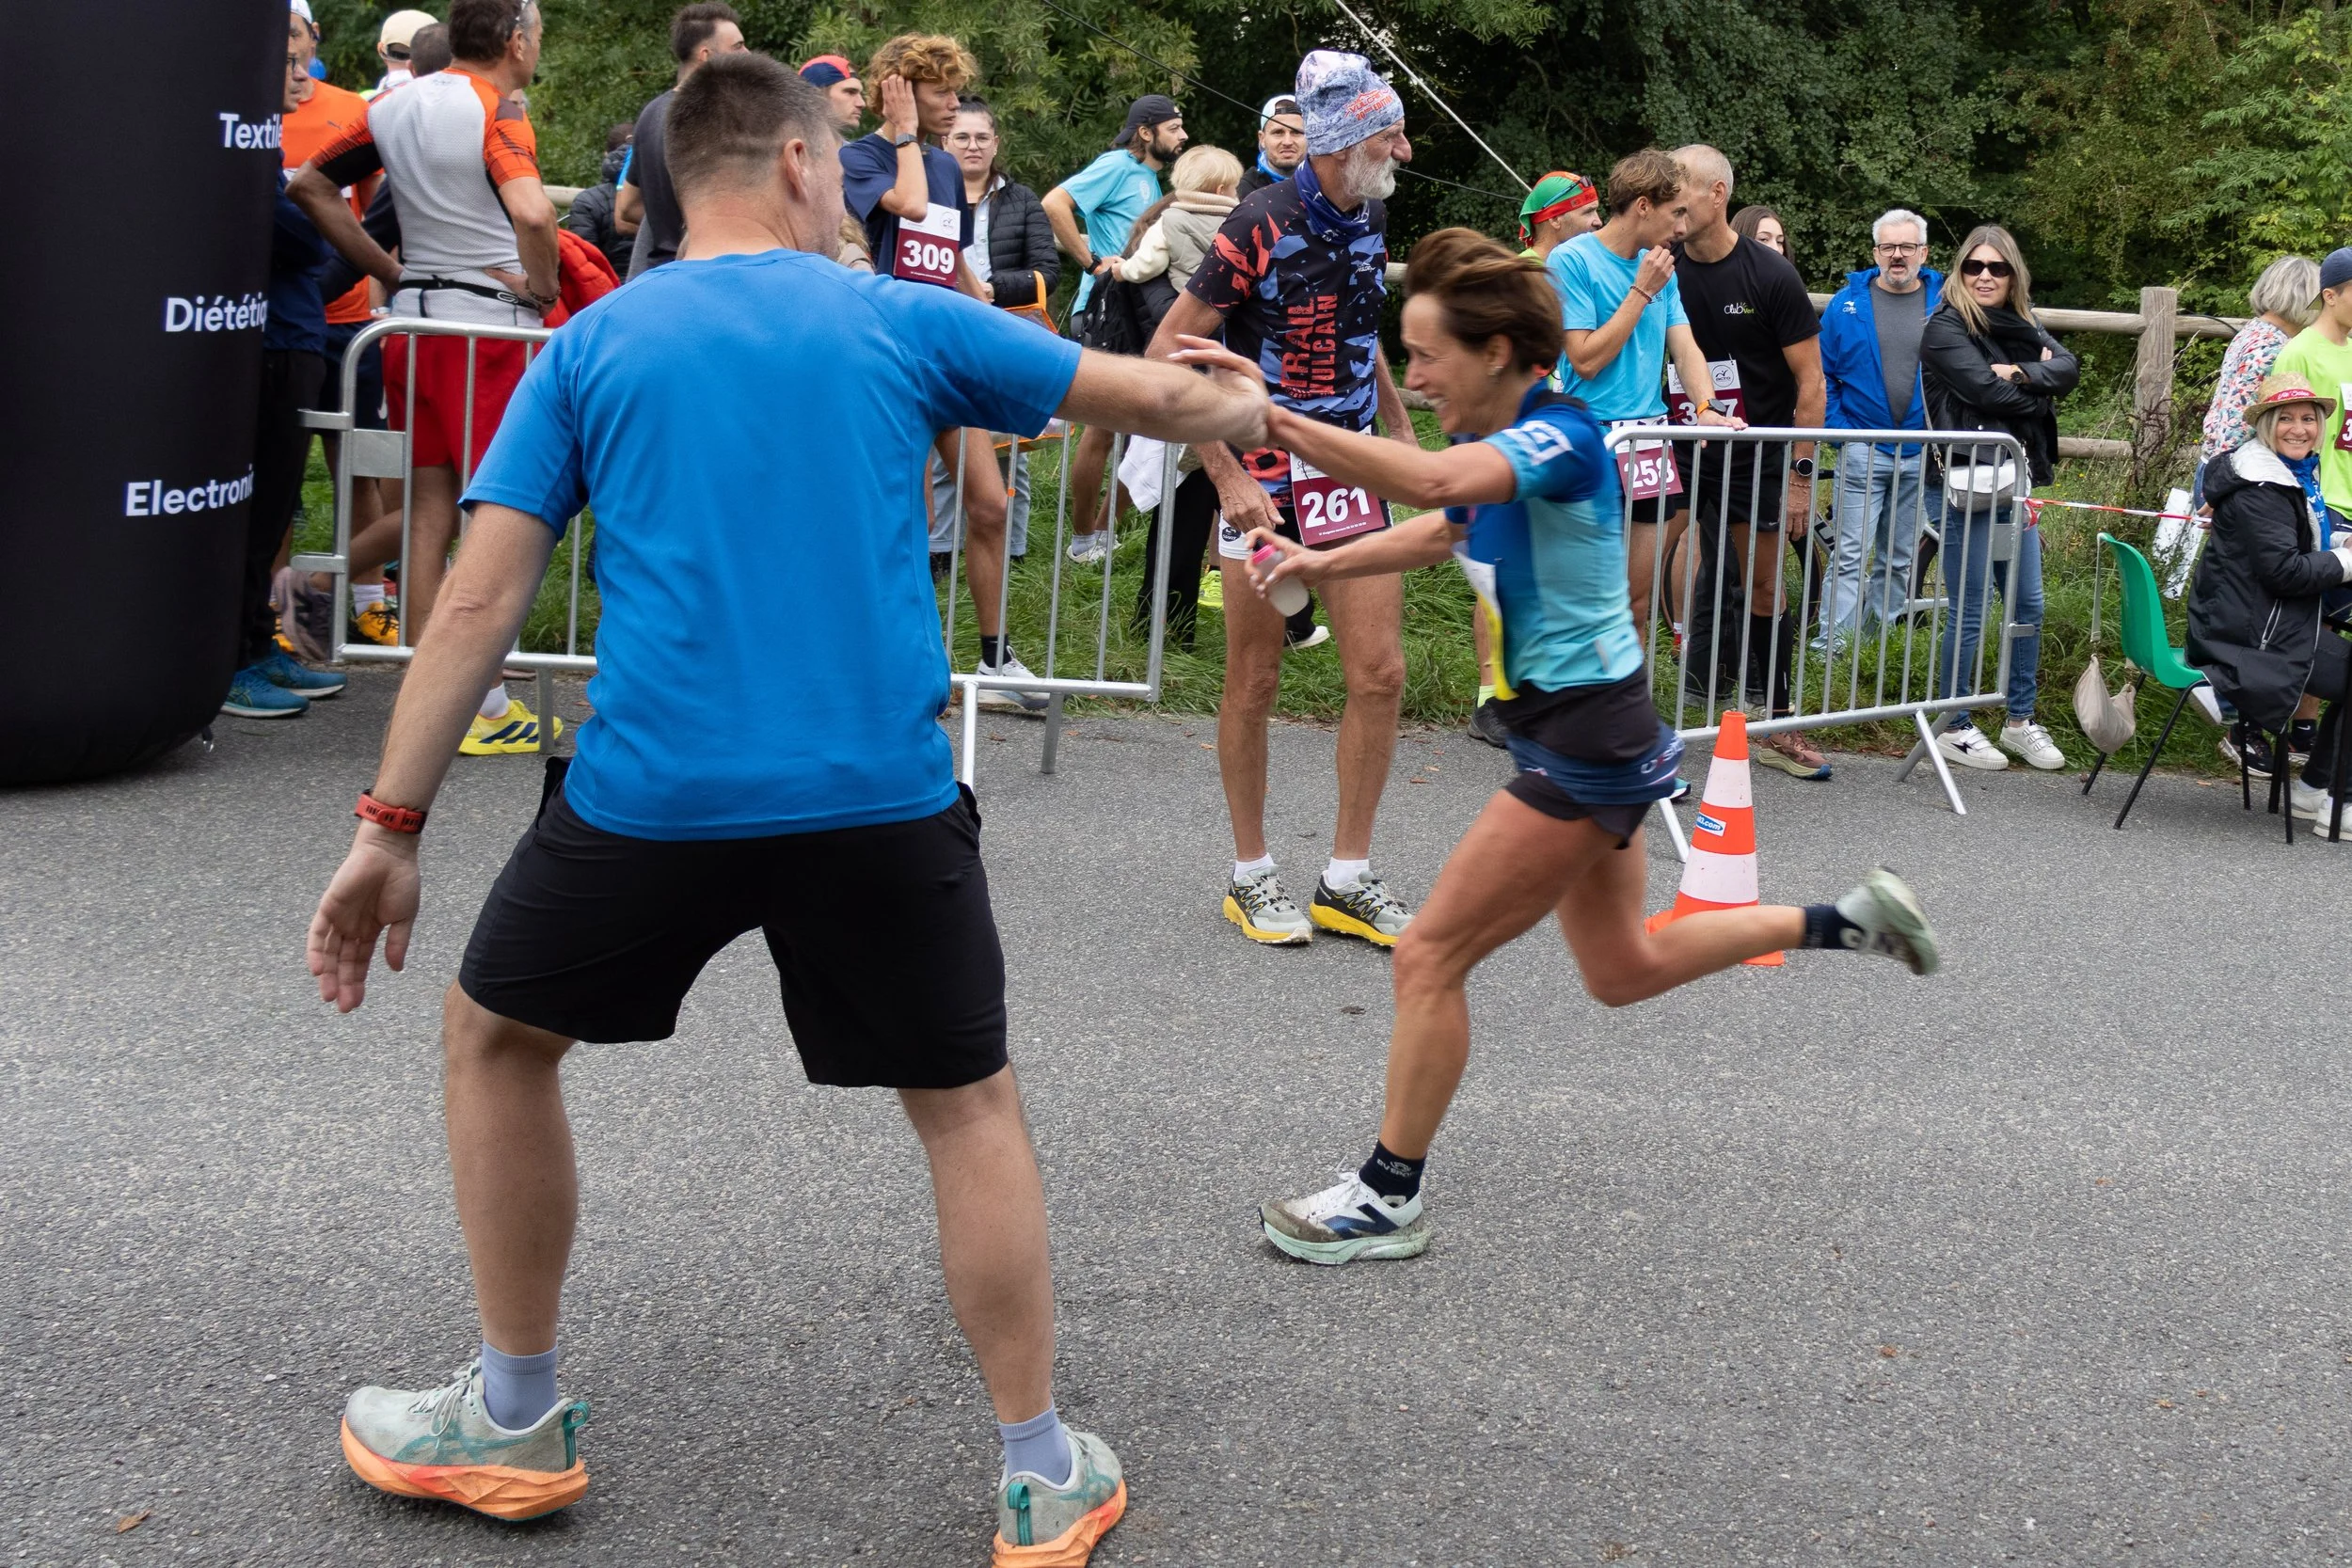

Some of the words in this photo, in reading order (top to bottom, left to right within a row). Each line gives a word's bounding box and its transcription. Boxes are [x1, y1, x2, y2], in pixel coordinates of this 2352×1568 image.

[901, 239, 955, 274] 309
[1280, 297, 1314, 388] TRAIL
[1309, 295, 1338, 395] VULCAIN
[1678, 399, 1739, 425] 37
[1624, 457, 1675, 488] 258
[1301, 486, 1371, 529] 261
